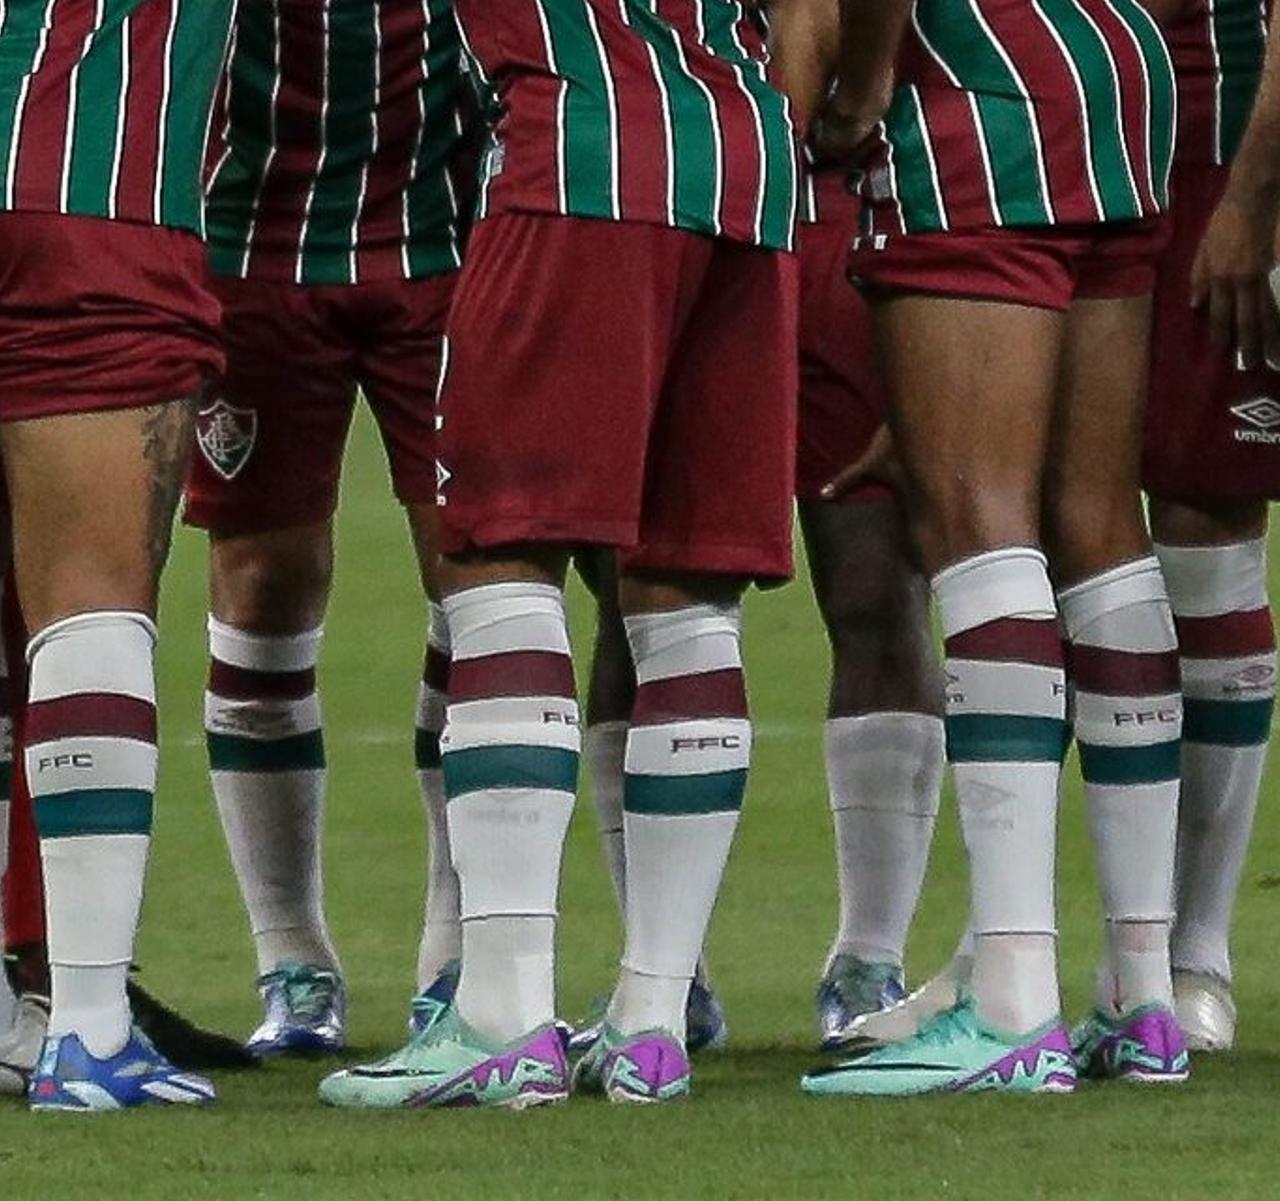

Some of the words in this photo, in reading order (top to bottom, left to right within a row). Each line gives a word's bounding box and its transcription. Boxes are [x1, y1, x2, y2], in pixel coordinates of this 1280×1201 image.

[1114, 709, 1176, 727] FFC
[671, 736, 741, 754] FFC
[38, 753, 94, 773] FFC
